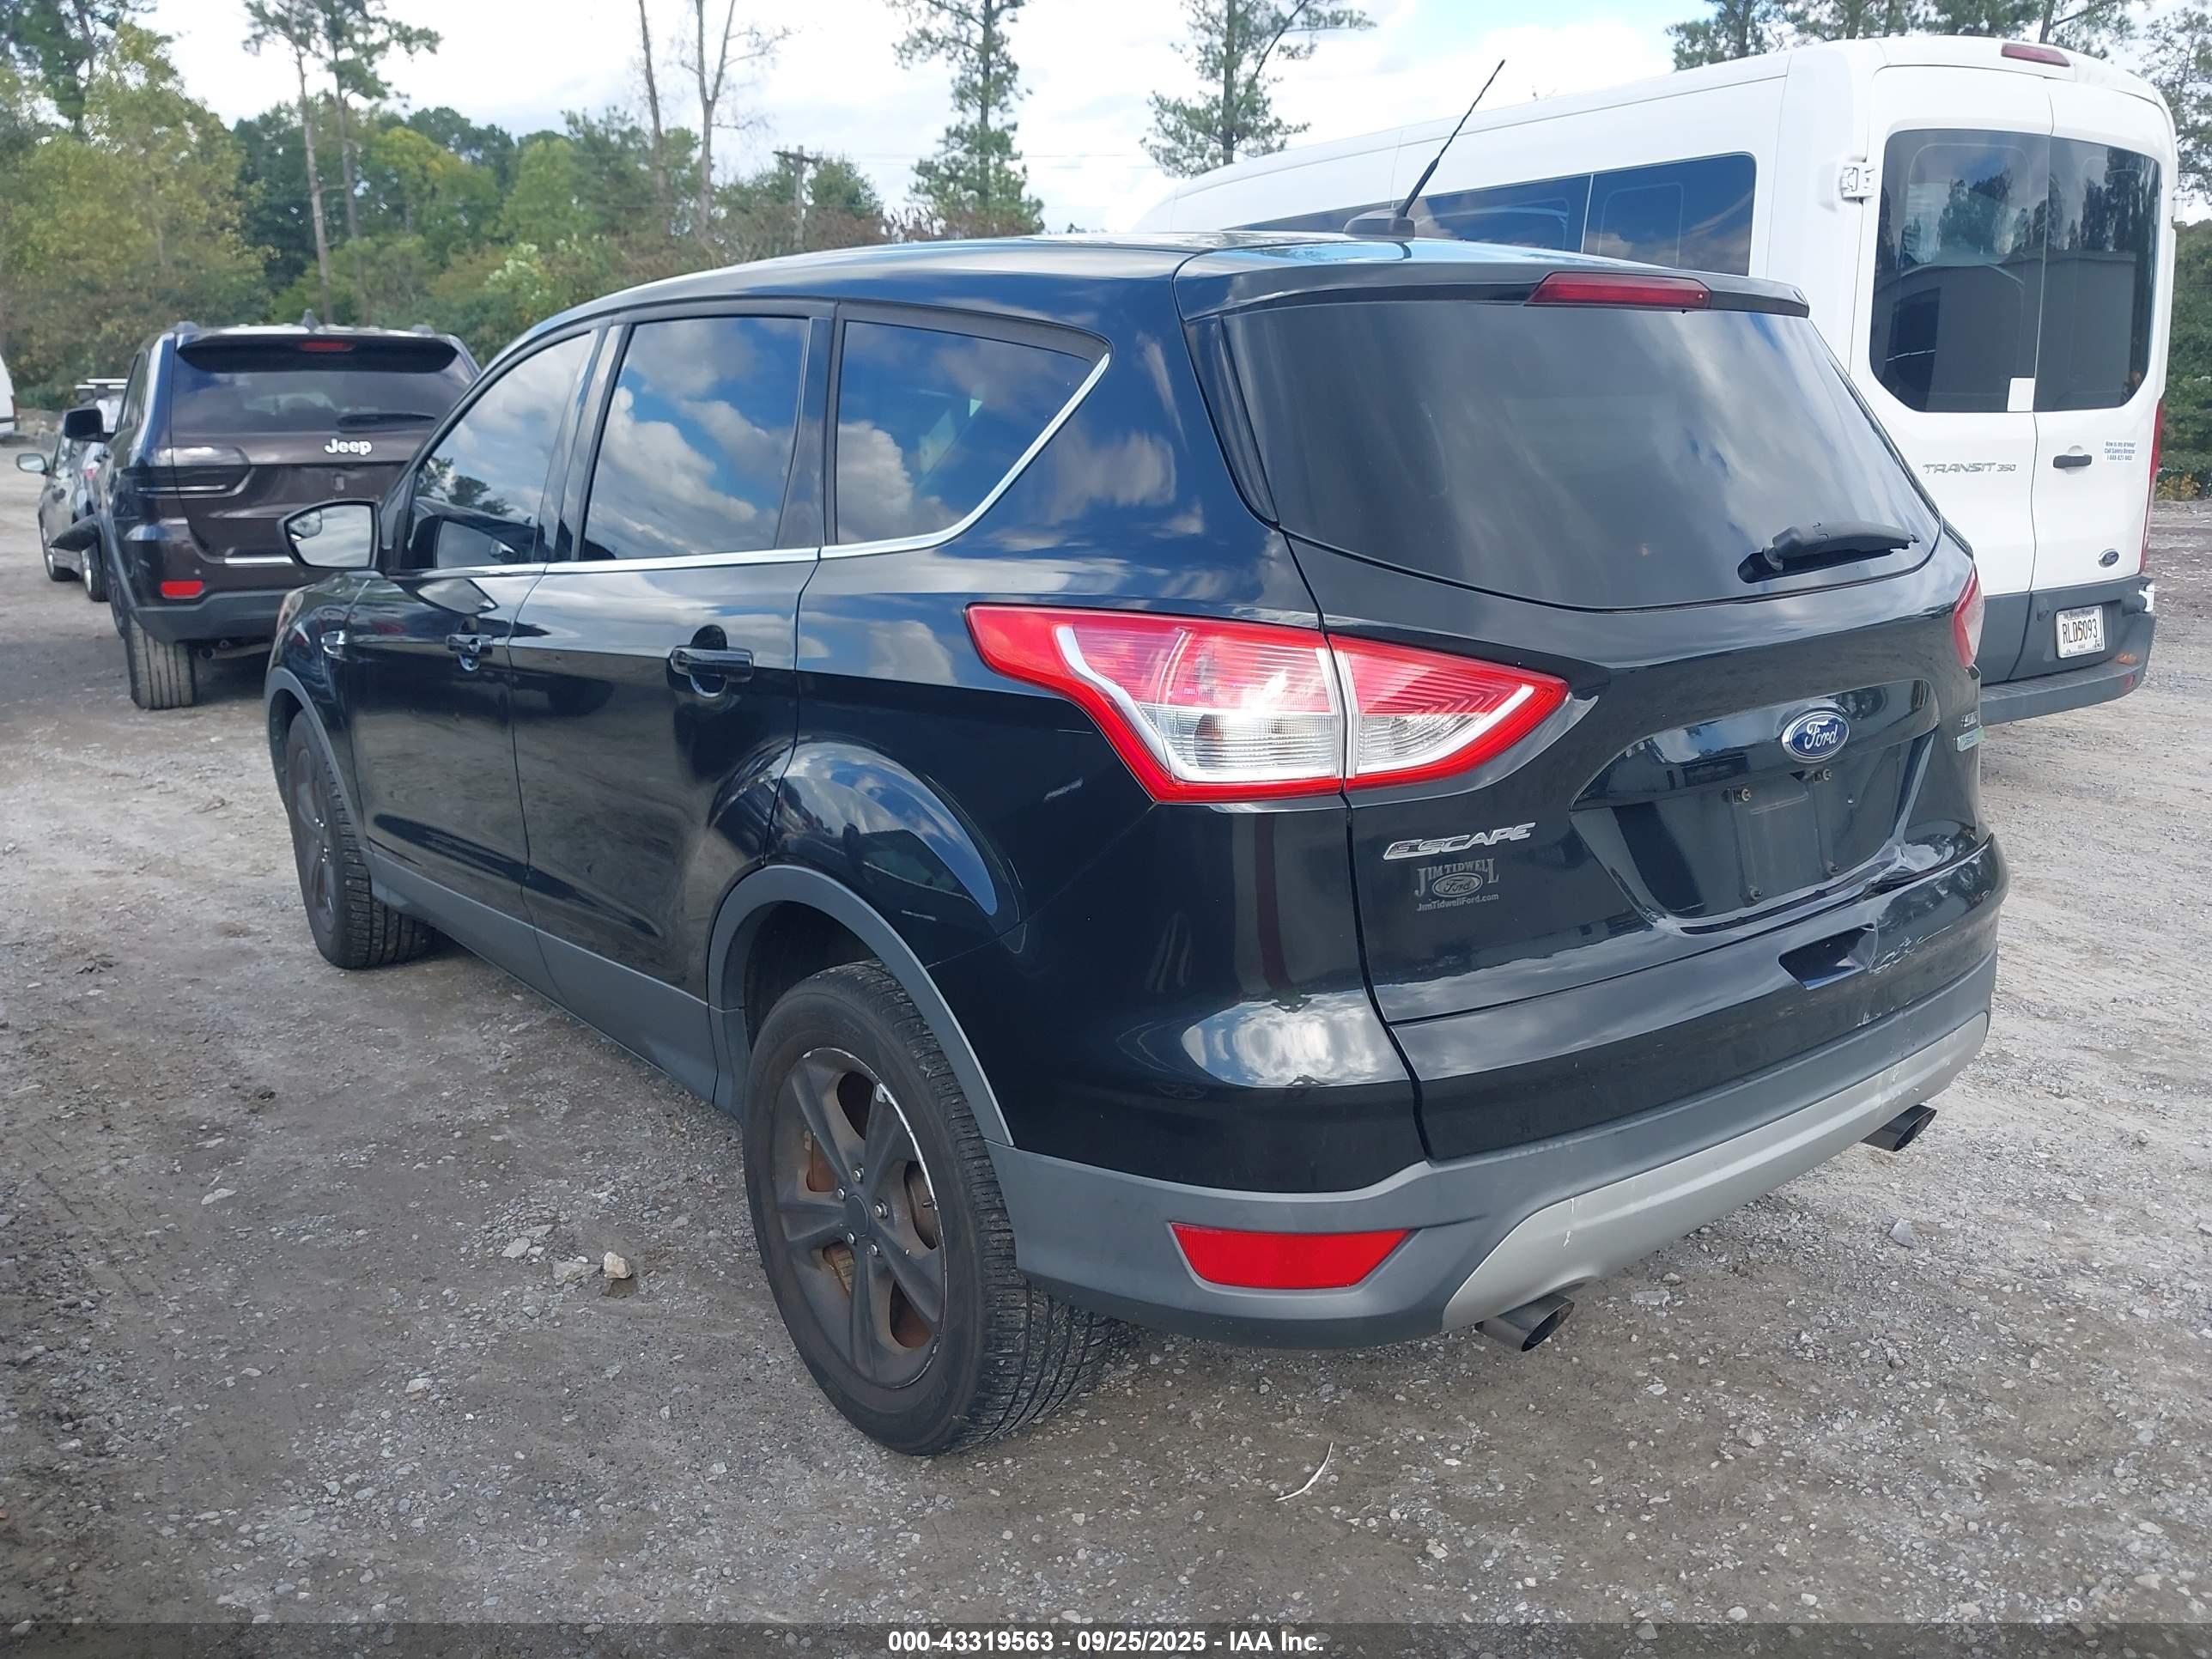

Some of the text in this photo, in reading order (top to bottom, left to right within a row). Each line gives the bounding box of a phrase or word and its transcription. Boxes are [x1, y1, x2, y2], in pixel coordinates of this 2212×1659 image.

[324, 438, 372, 456] Jeep
[1923, 462, 2016, 474] TRANSIT 350
[2062, 617, 2098, 645] RLD5093
[1804, 719, 1839, 750] Ford
[1382, 822, 1537, 860] ESCAPE
[1414, 858, 1499, 897] JIM TIDWELL
[1416, 893, 1499, 912] JimTidwellFord.com
